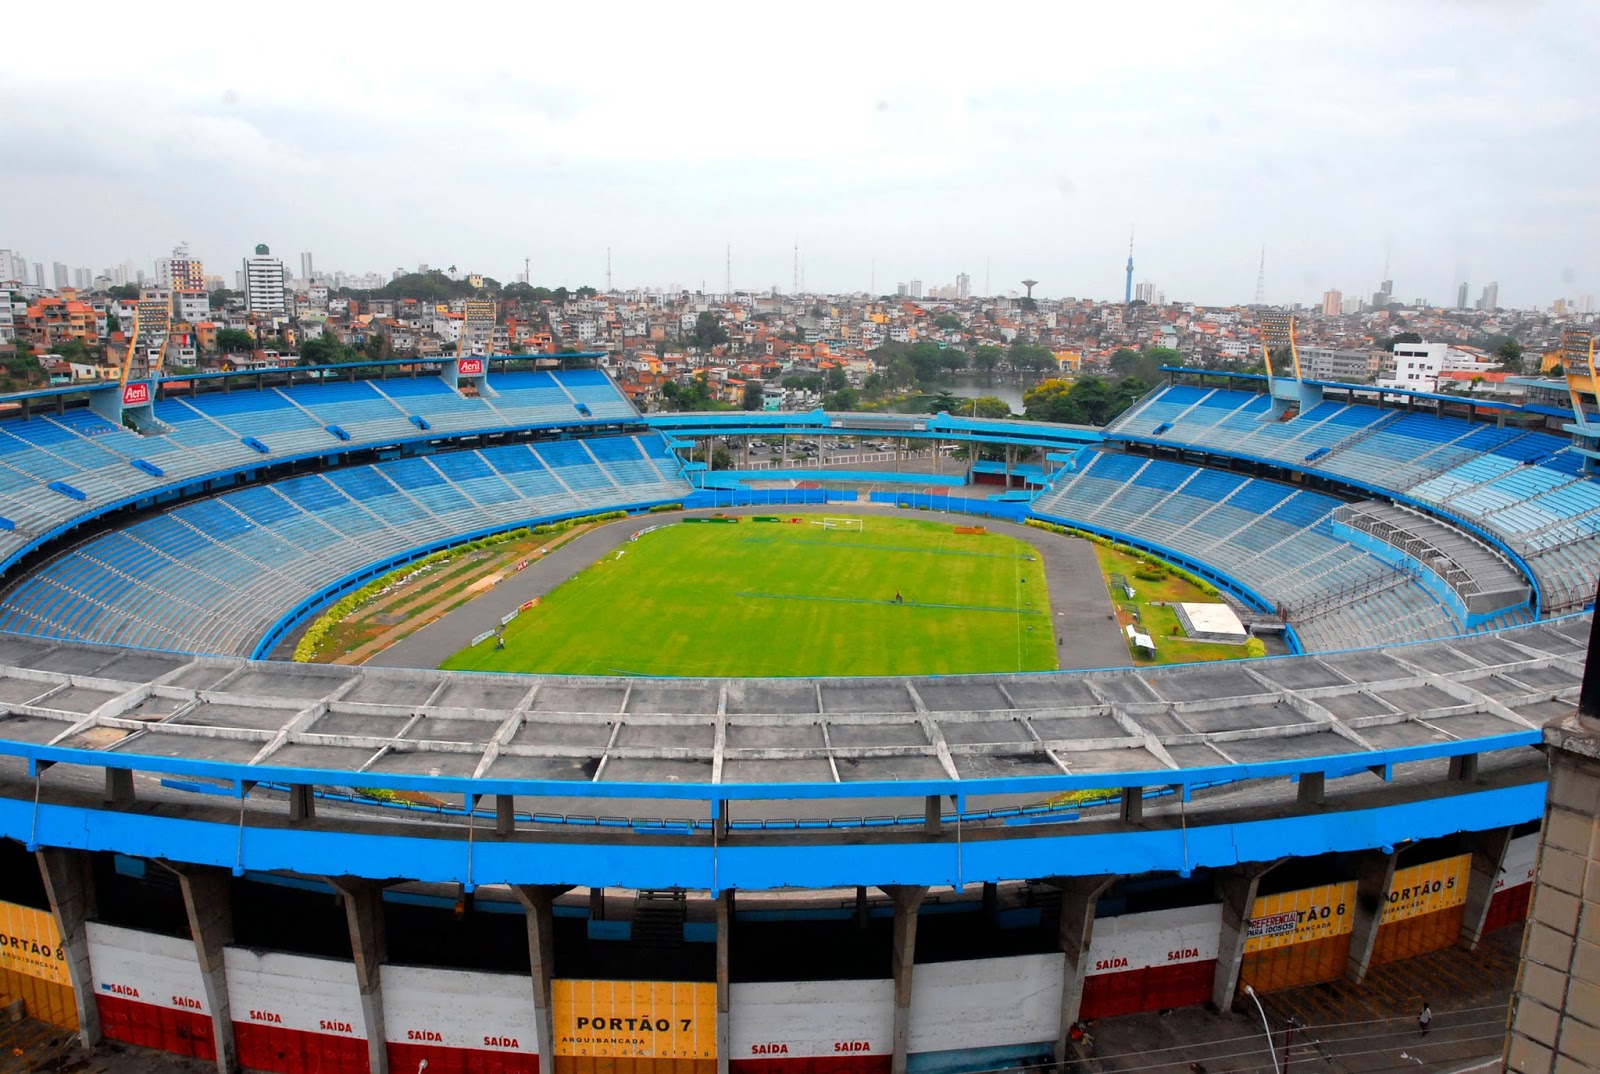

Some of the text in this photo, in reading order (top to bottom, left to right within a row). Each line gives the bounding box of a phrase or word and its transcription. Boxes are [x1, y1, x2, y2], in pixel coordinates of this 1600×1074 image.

[1389, 877, 1455, 903] ORTÃO 5
[1297, 903, 1345, 923] TÃO 6
[1383, 901, 1424, 915] UIBANCADA
[1247, 922, 1294, 937] PARA IDOSOS
[0, 934, 65, 961] ORTÃO 8
[1096, 947, 1199, 971] SAÍDA SAÍDA
[110, 984, 202, 1010] SAÍDA SAÍDA
[249, 1010, 353, 1033] SAÍDA SAÍDA
[577, 1014, 692, 1032] PORTÃO 7
[407, 1029, 519, 1048] SAÍDA SAÍDA
[561, 1037, 646, 1045] ARQUIBANCADA
[751, 1040, 870, 1054] SAÍDA SAÍDA
